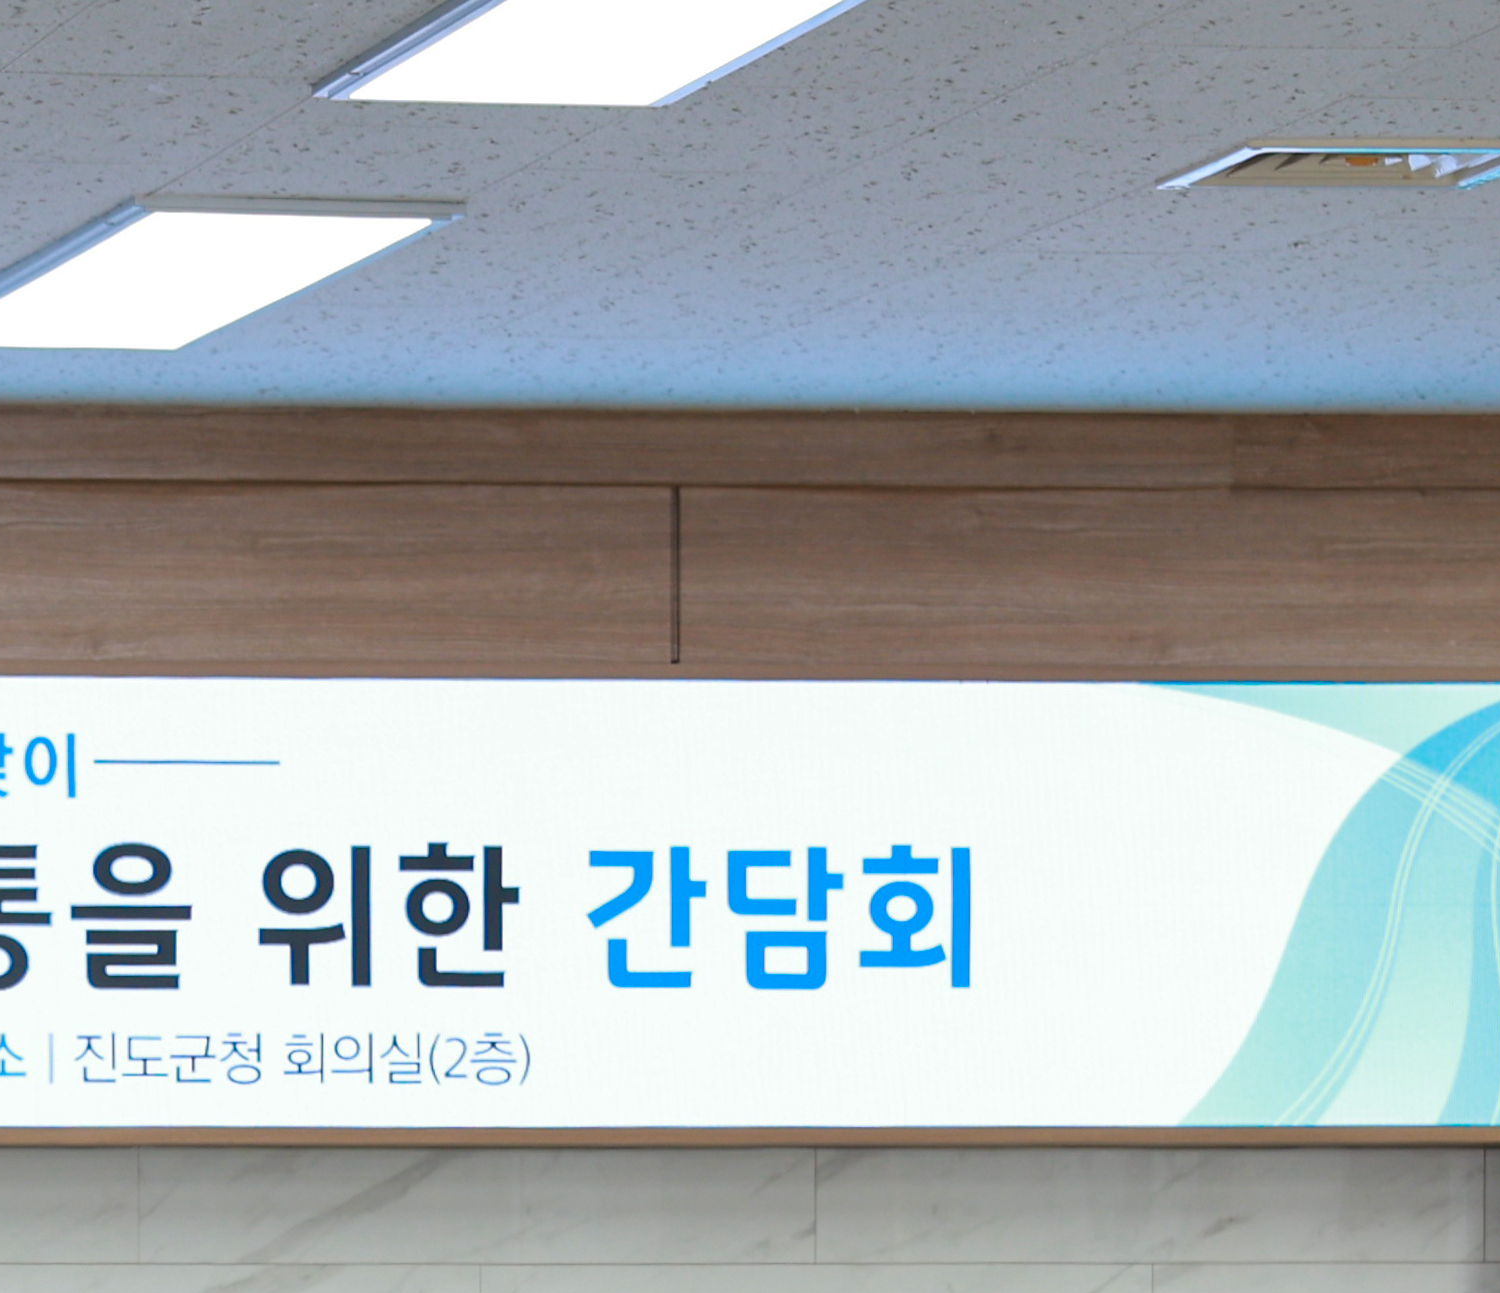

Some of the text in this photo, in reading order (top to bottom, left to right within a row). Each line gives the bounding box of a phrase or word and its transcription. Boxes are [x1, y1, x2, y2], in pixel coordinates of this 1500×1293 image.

[257, 841, 521, 989] 위한
[586, 843, 972, 991] 간담회
[74, 1031, 263, 1086] 진도군청
[282, 1031, 532, 1087] 회의실(2층)
